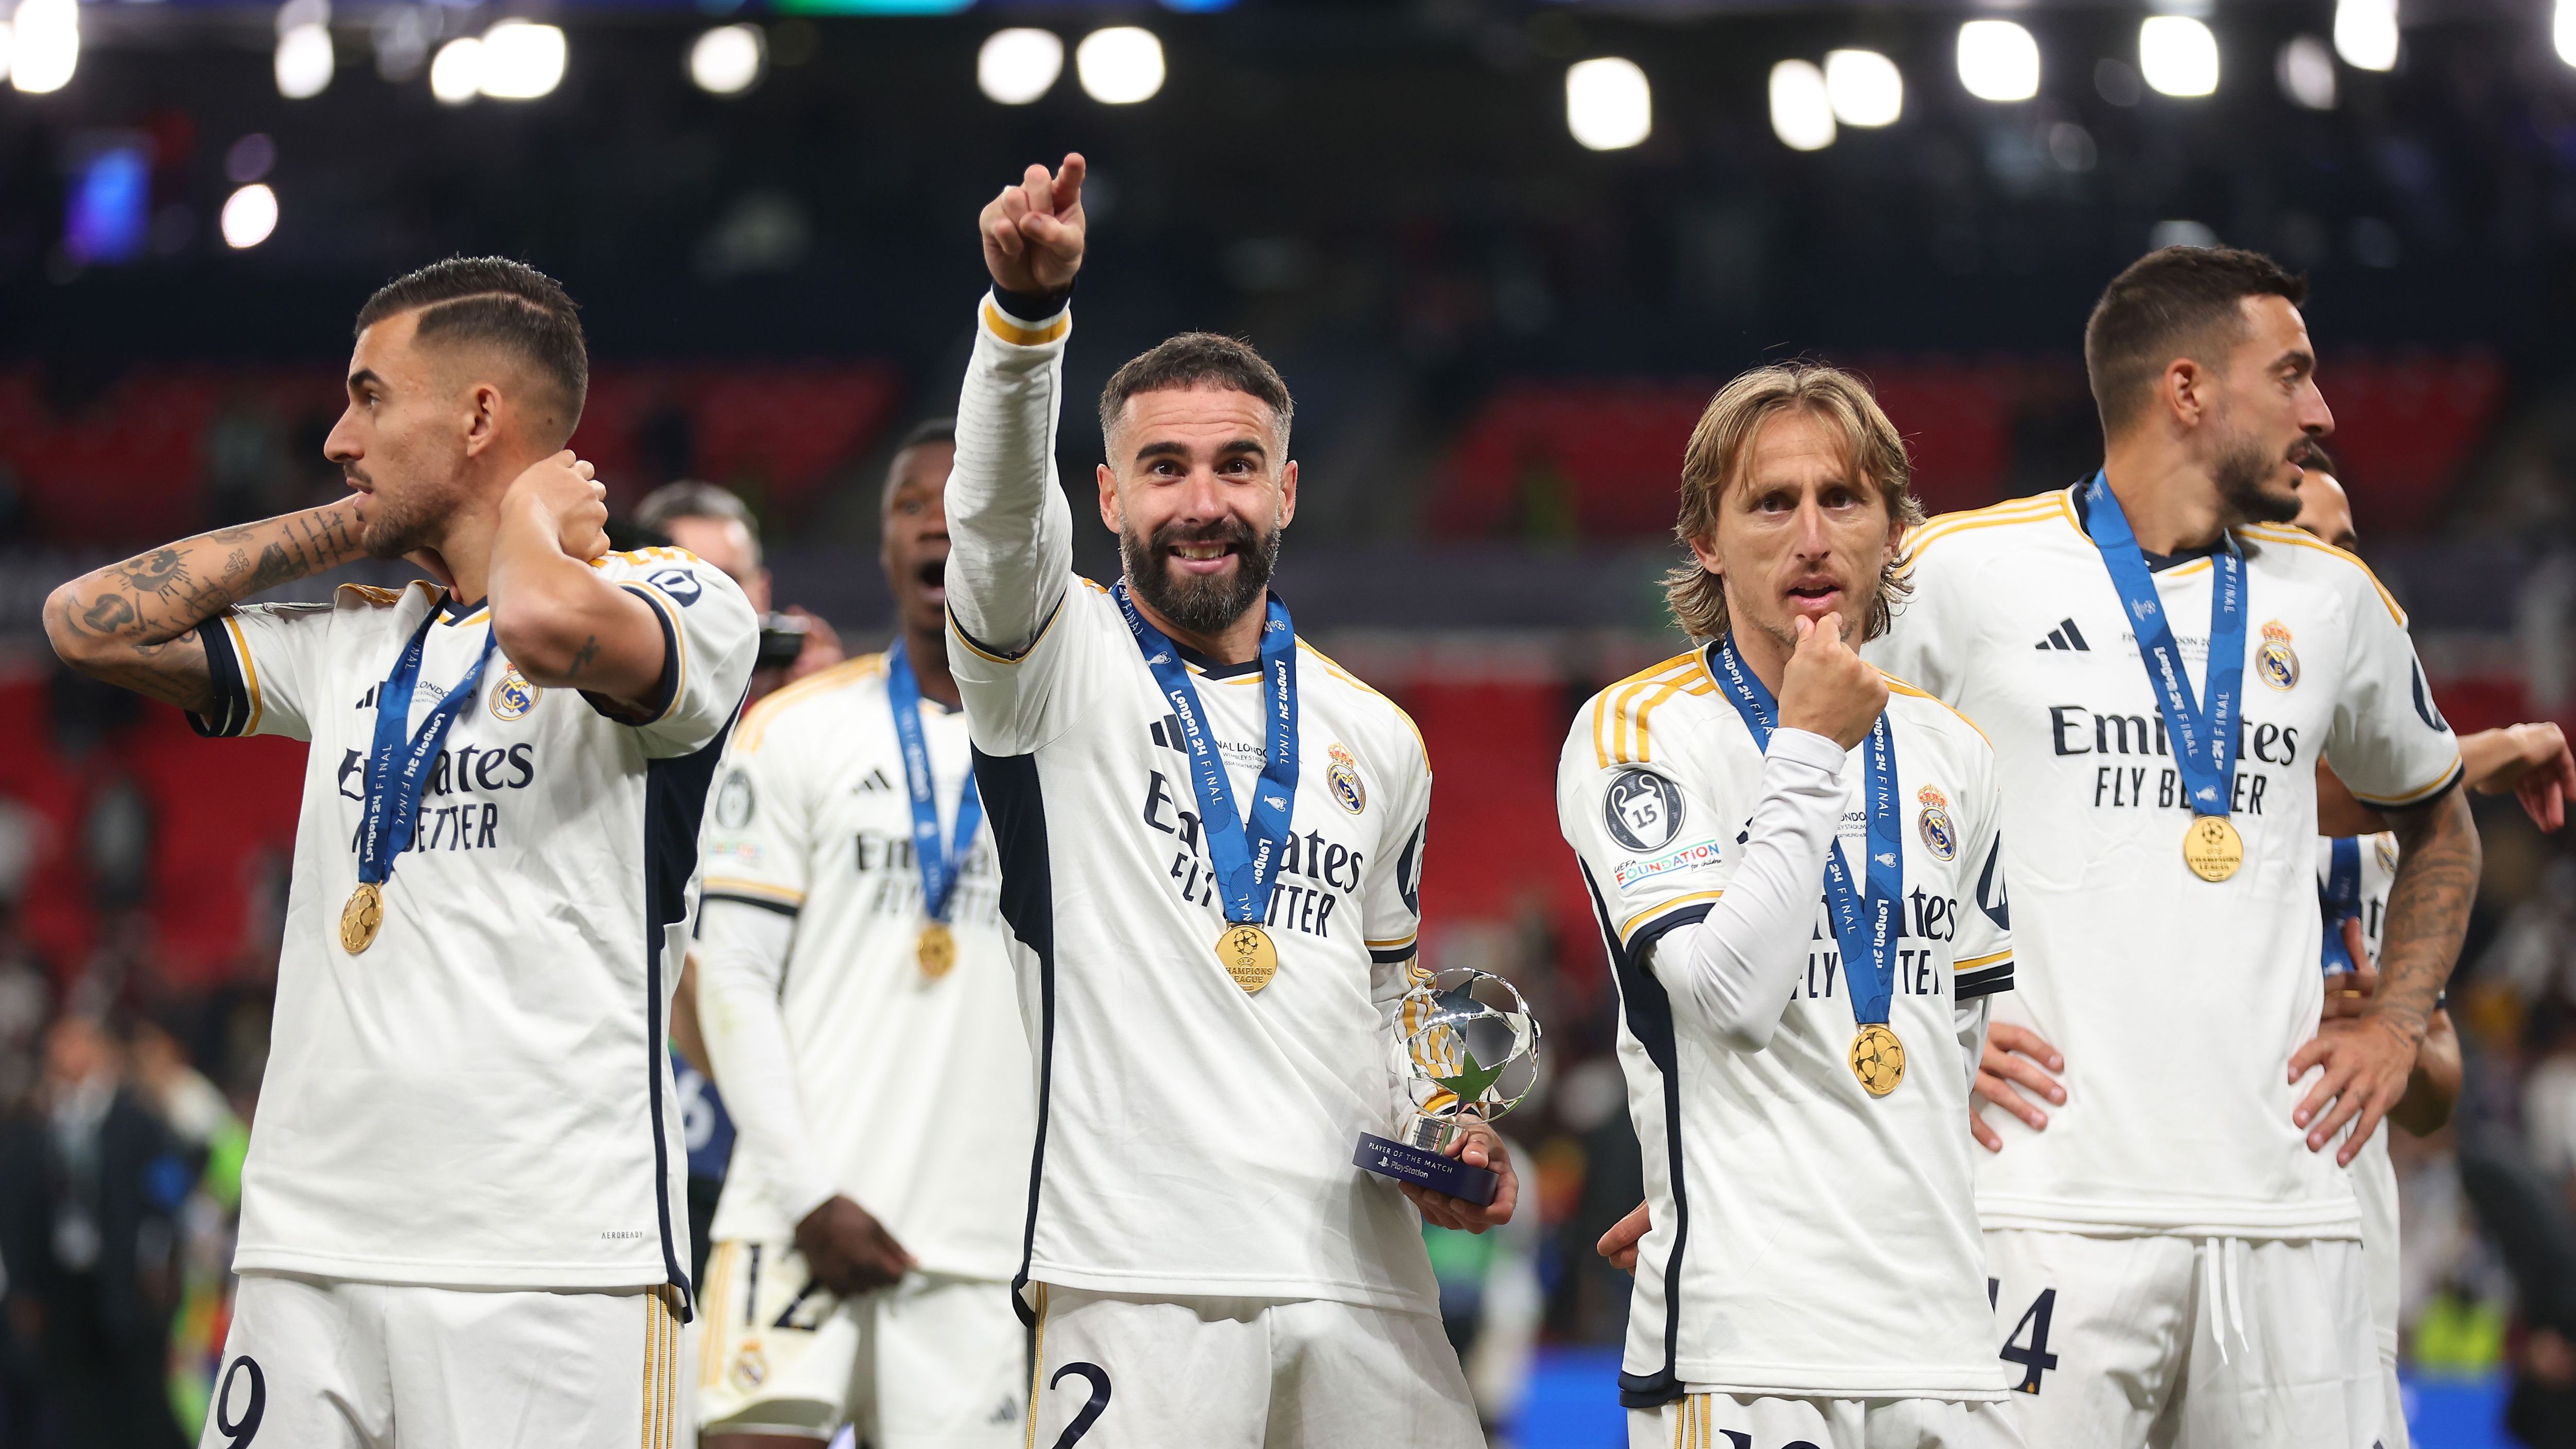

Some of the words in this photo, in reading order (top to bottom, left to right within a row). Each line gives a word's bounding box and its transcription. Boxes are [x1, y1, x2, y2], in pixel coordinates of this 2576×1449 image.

[2224, 574, 2237, 613] FINAL
[1122, 603, 1143, 637] FINAL
[405, 643, 421, 670] NAL
[415, 680, 450, 699] LONDO
[1737, 685, 1754, 701] 24
[1750, 704, 1774, 735] FINA
[1279, 702, 1289, 720] 24
[2214, 692, 2230, 737] FINAL
[1215, 740, 1234, 752] NAL
[1237, 743, 1267, 758] LONDO
[1223, 752, 1248, 760] WEMBLEY
[1280, 723, 1290, 764] FINAL
[2048, 705, 2299, 766] Emites
[2177, 713, 2199, 758] FINAL
[338, 743, 534, 801] Eates
[375, 744, 392, 790] FINAL
[404, 757, 421, 778] 24
[1192, 738, 1208, 756] 24
[1200, 760, 1224, 806] FINAL
[1875, 752, 1886, 772] 24
[372, 794, 383, 813] 24
[395, 780, 411, 825] FINAL
[1877, 776, 1889, 819] FINAL
[2095, 766, 2146, 807] FLY
[401, 802, 498, 853] ETTER
[1144, 769, 1364, 894] Eates
[1632, 804, 1658, 829] 15
[1614, 860, 1637, 874] UEFA
[1616, 843, 1720, 885] FOUNDATION
[1691, 863, 1699, 871] for
[1701, 859, 1722, 867] children
[1238, 893, 1253, 922] NAL
[1267, 883, 1336, 938] TTER
[1829, 863, 1843, 883] 24
[1837, 887, 1856, 934] FINAL
[1790, 952, 1838, 1000] LY
[1368, 1142, 1391, 1154] PLAYER
[1406, 1154, 1422, 1164] THE
[1424, 1160, 1453, 1174] MATCH
[1390, 1160, 1429, 1179] PlayStation
[601, 1231, 642, 1239] AEROREADY
[217, 1355, 266, 1449] 9
[1050, 1361, 1112, 1449] 2
